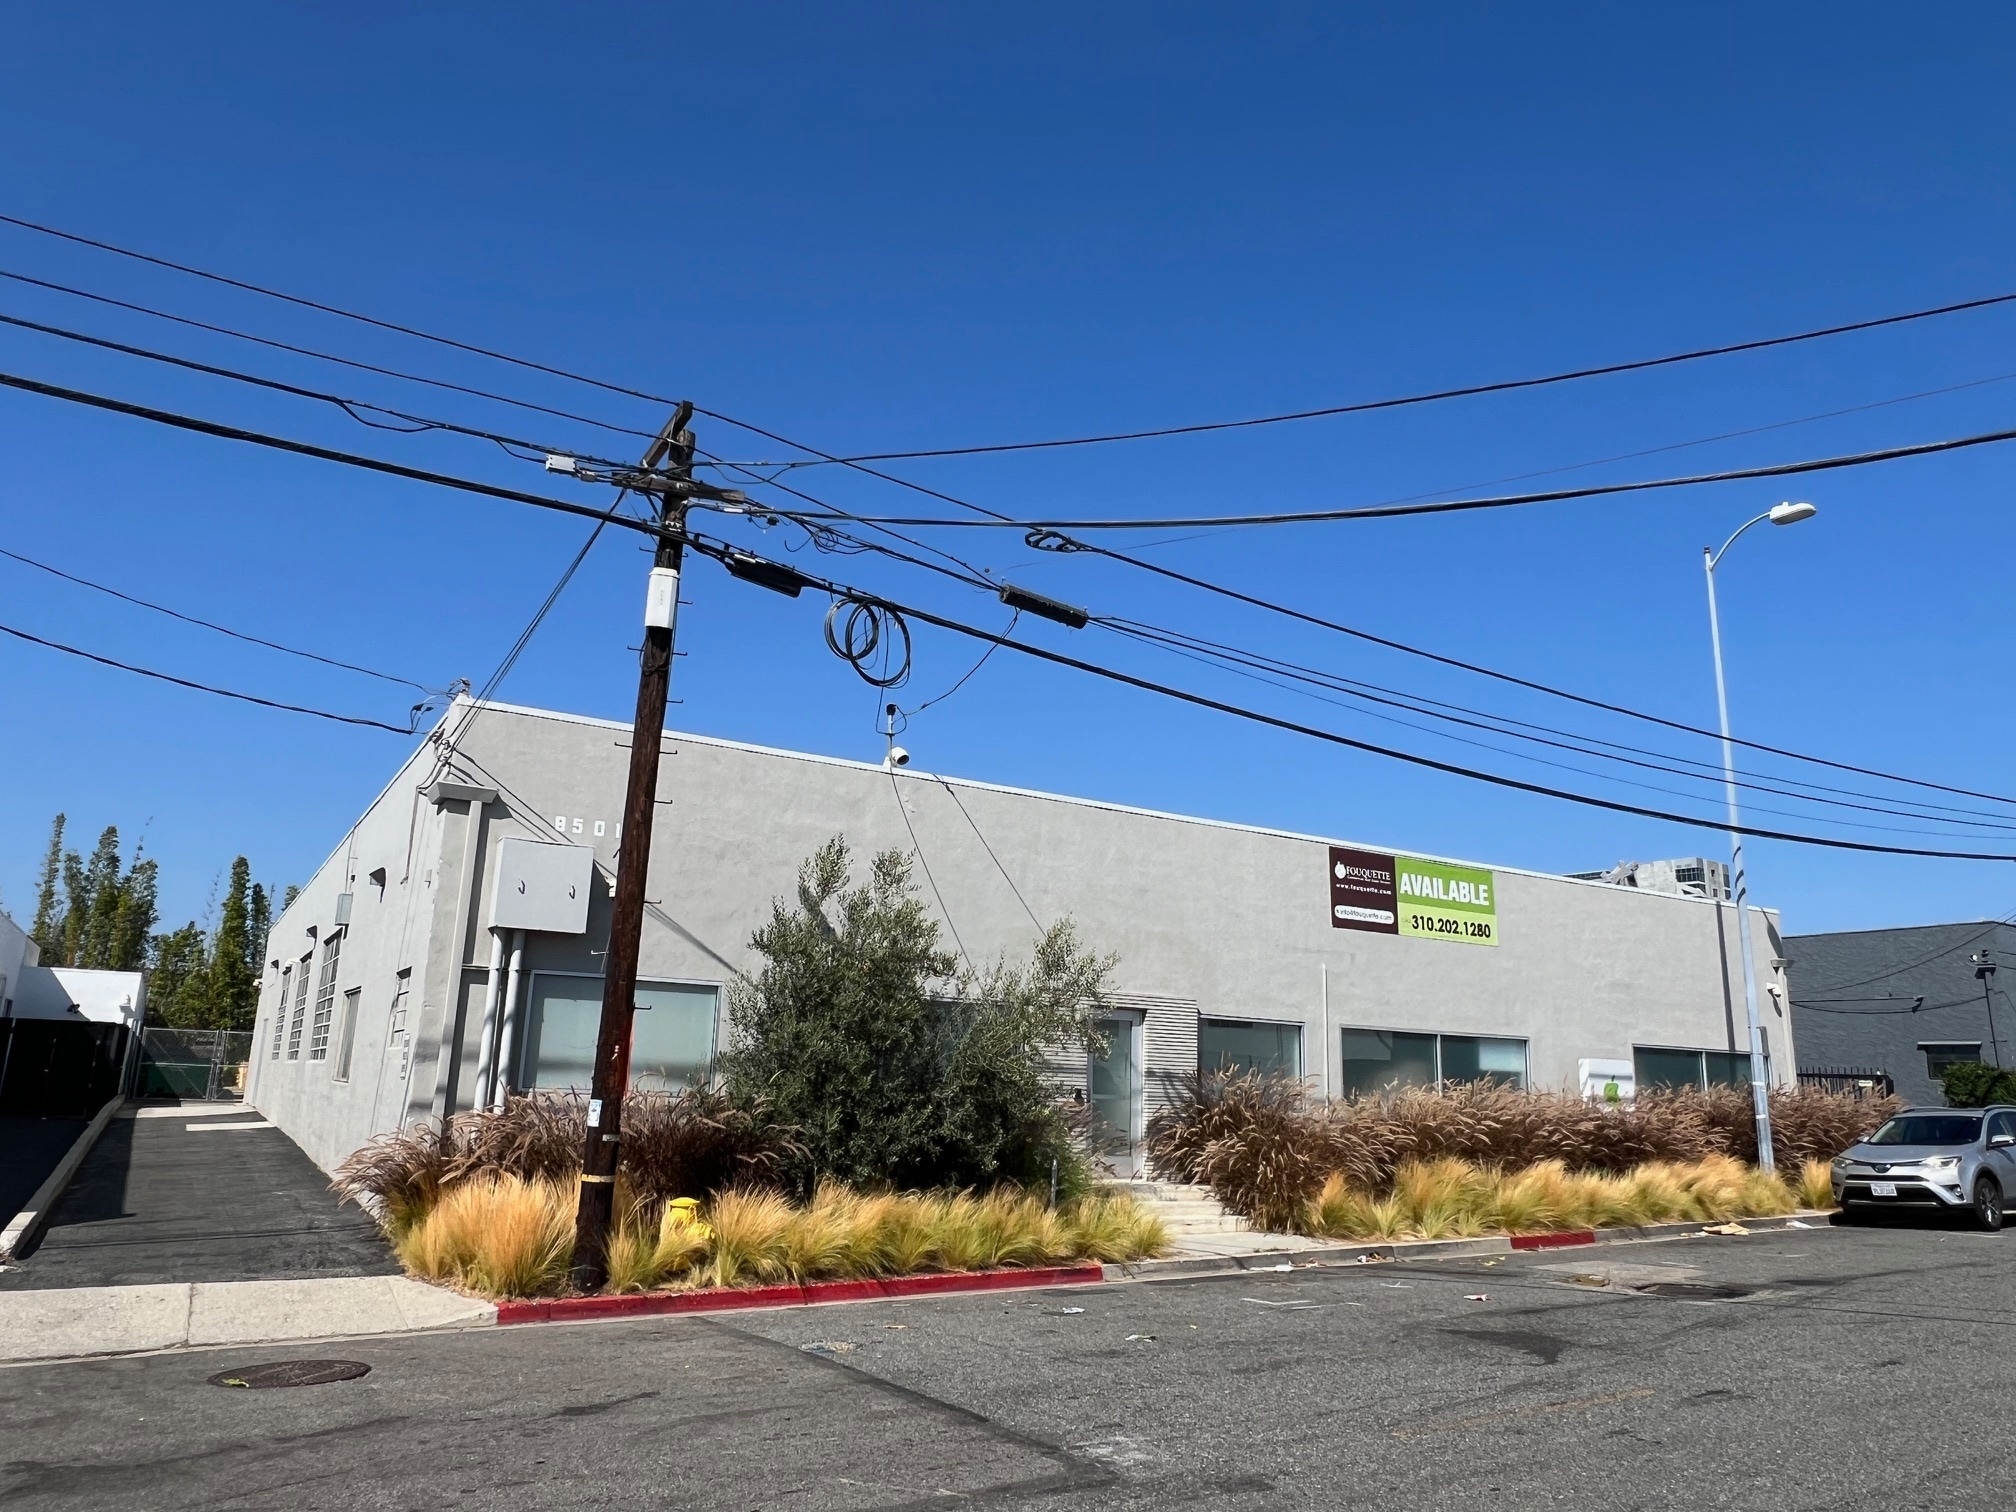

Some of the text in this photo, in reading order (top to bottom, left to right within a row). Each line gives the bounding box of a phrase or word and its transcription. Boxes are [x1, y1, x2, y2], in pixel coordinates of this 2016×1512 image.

[555, 816, 621, 839] 8501
[1346, 866, 1391, 880] FOUQUETTE
[1400, 873, 1490, 906] AVAILABLE
[1412, 915, 1491, 938] 310.202.1280
